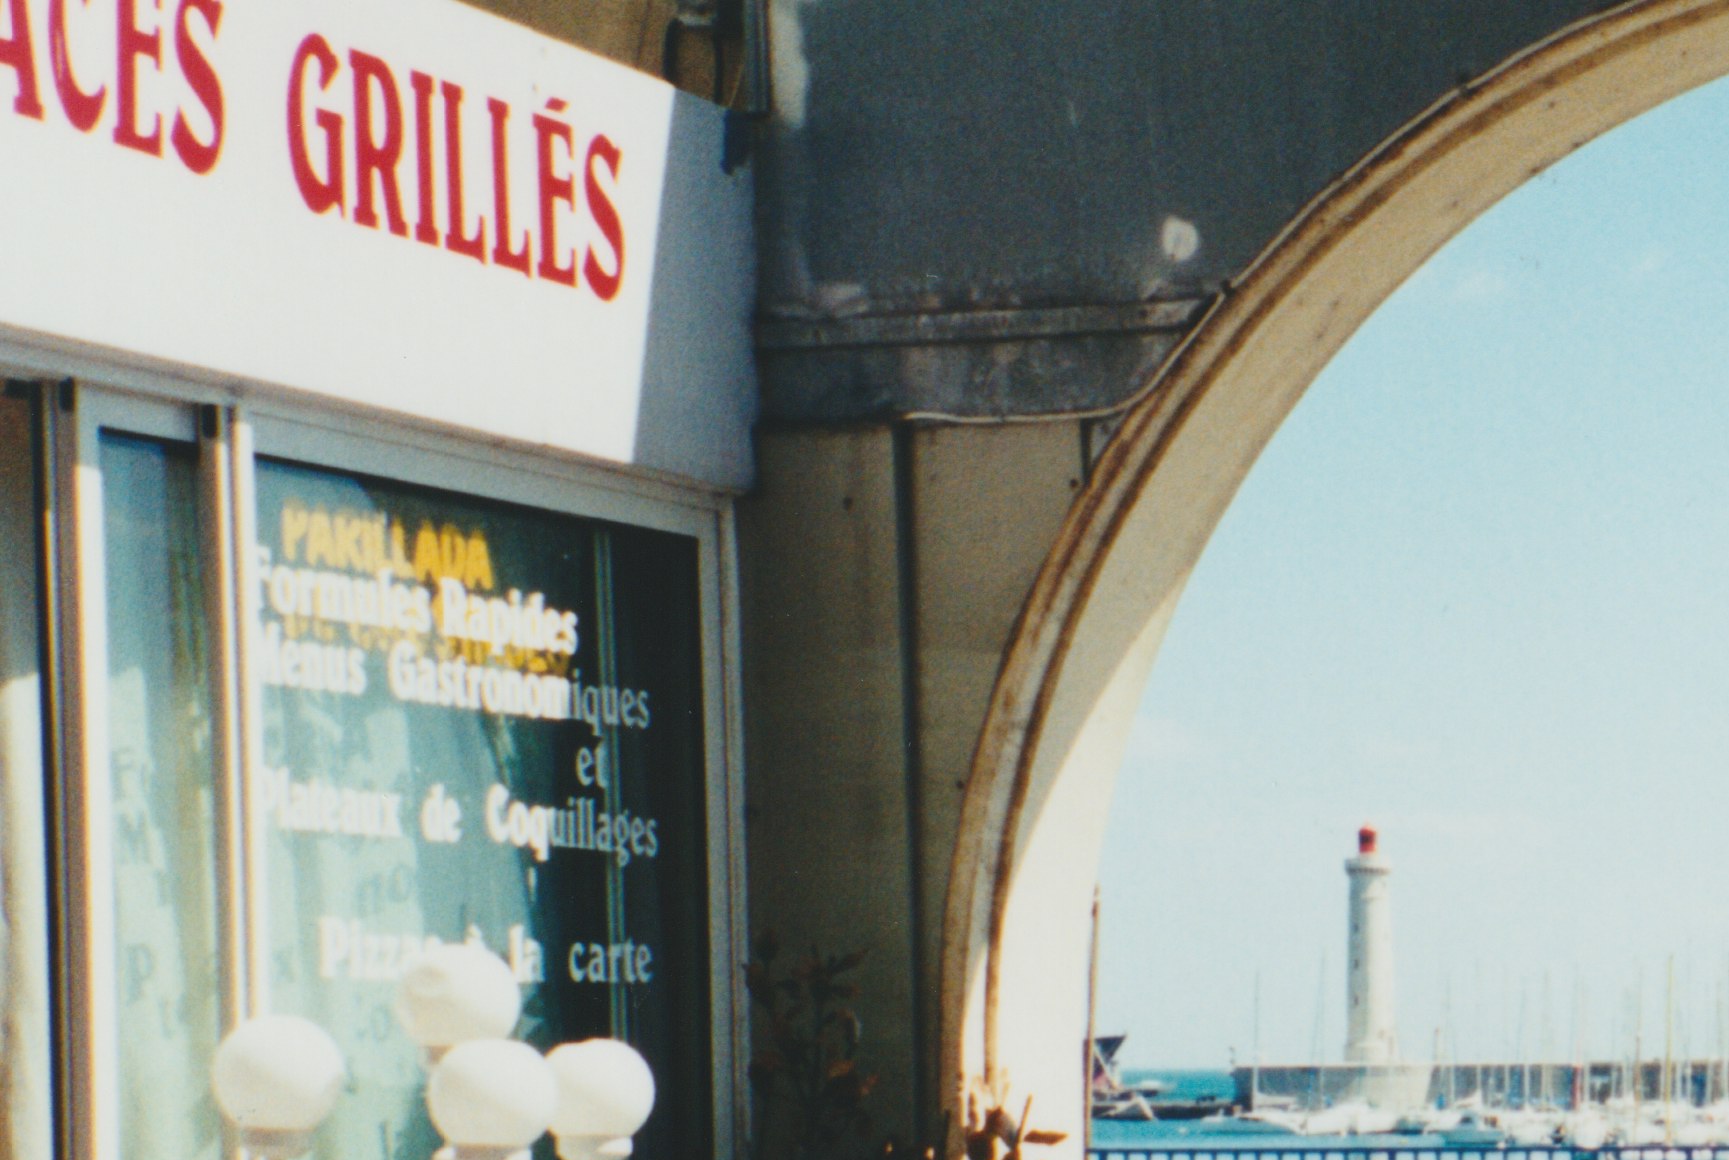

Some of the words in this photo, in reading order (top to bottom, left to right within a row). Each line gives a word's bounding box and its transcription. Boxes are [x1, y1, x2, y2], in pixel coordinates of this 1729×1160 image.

[286, 32, 625, 302] GRILLÉS
[256, 544, 432, 634] Formules
[439, 576, 578, 655] Rapides
[387, 640, 650, 737] Gastronomiques
[420, 783, 463, 843] de
[485, 783, 659, 867] Coquillages
[567, 936, 653, 983] carte
